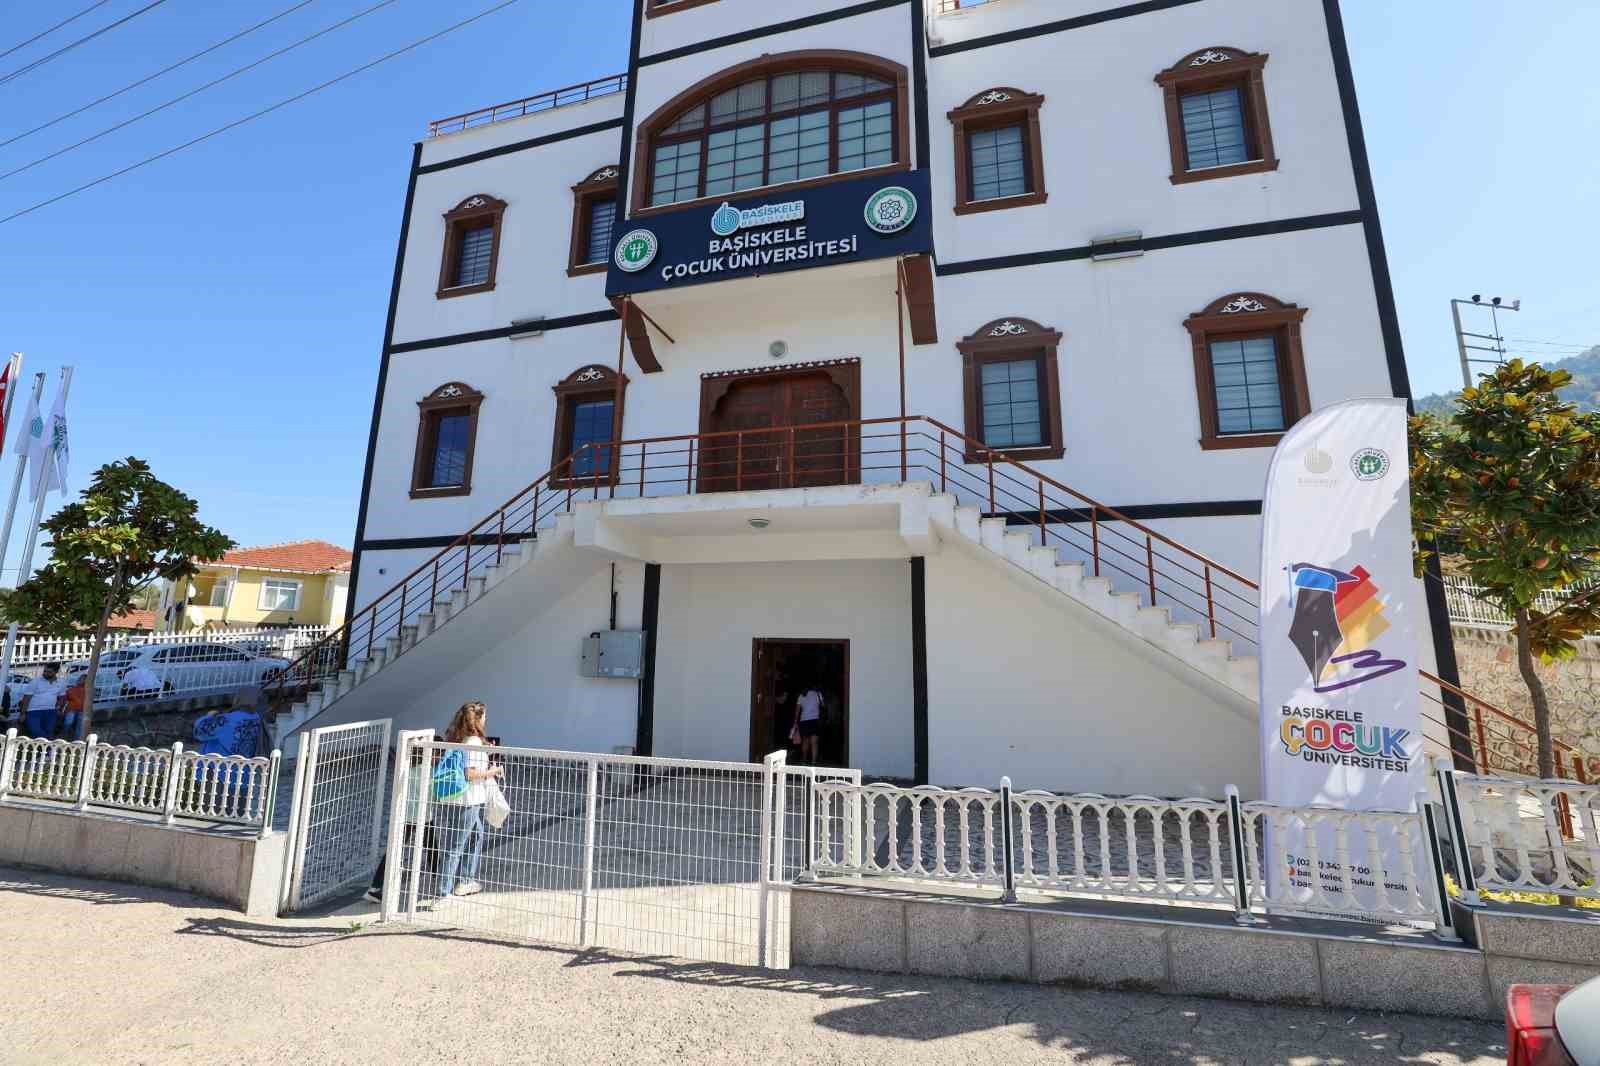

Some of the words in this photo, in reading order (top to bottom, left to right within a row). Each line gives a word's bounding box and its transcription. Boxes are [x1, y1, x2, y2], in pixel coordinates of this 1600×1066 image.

[709, 226, 807, 254] BAŞİSKELE
[661, 256, 725, 281] ÇOCUK
[728, 235, 857, 269] ÜNİVERSİTESİ
[1281, 705, 1364, 723] BAŞİSKELE
[1280, 718, 1410, 760] ÇOCUK
[1303, 750, 1408, 773] ÜNİVERSİTESİ
